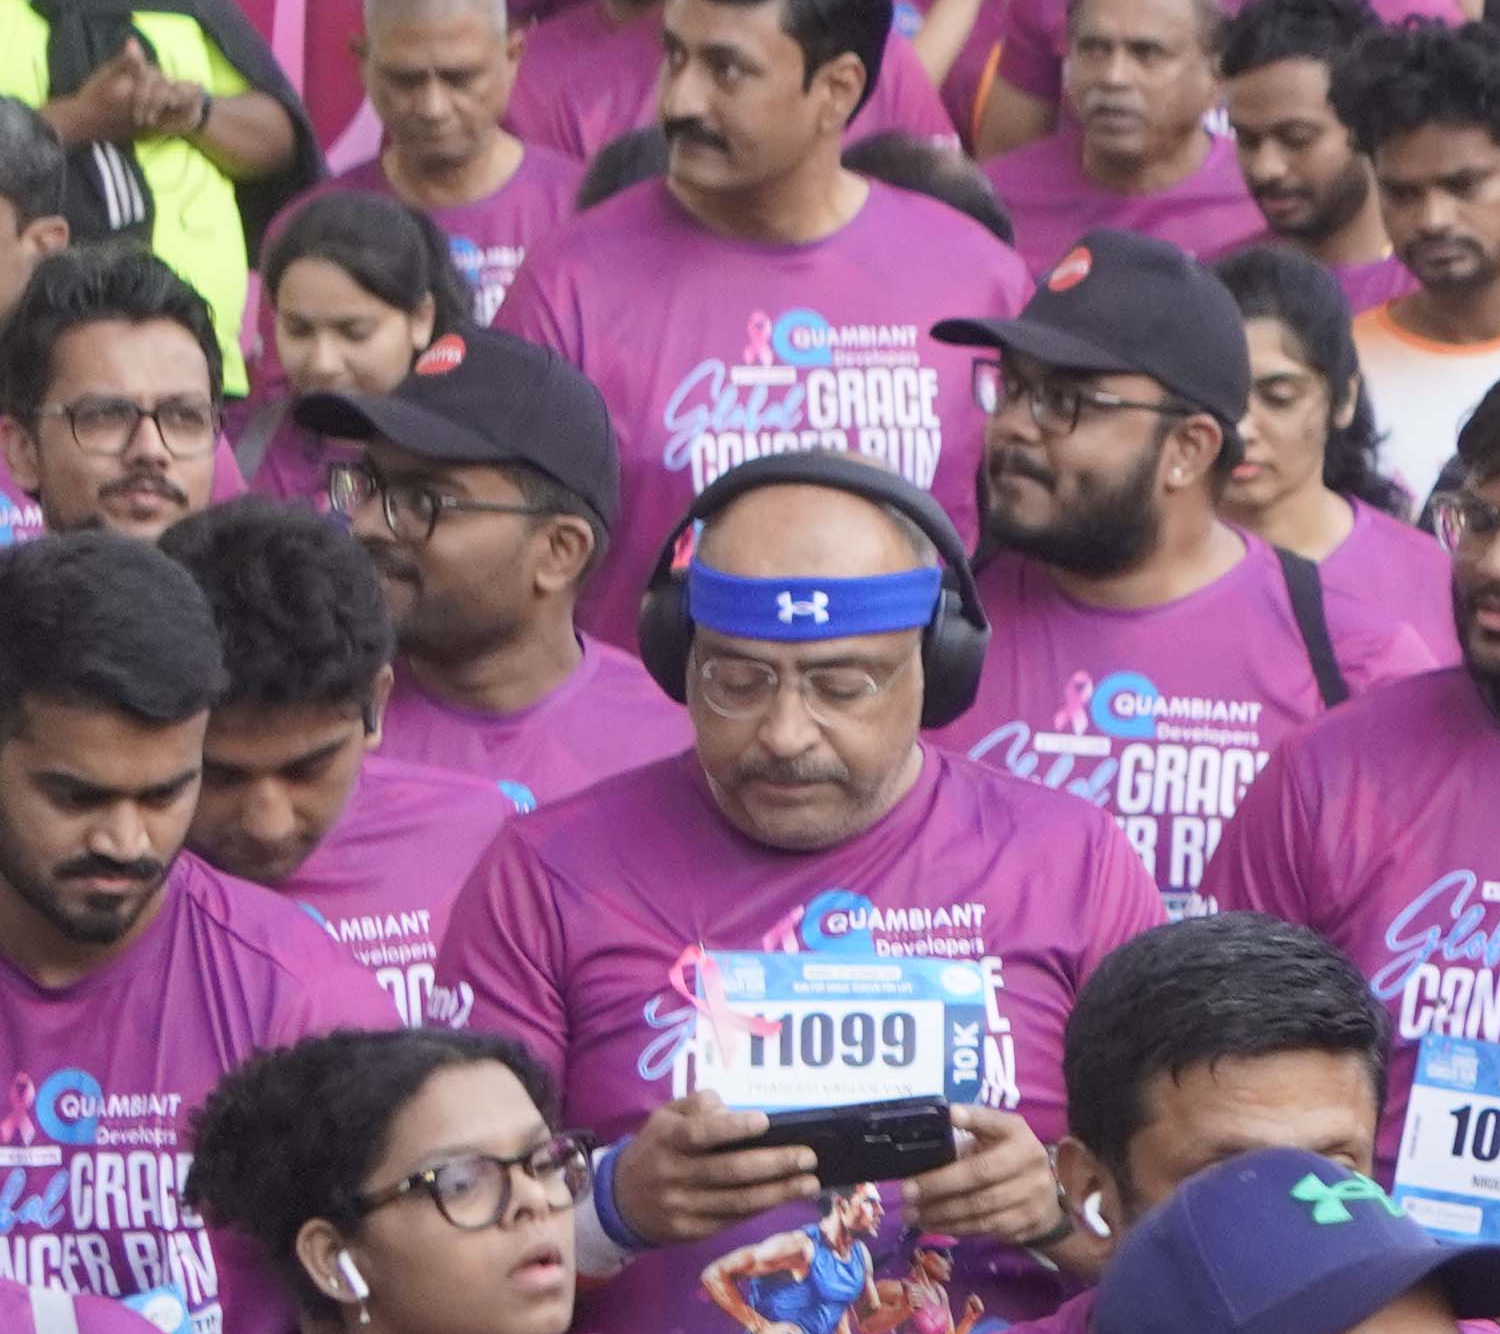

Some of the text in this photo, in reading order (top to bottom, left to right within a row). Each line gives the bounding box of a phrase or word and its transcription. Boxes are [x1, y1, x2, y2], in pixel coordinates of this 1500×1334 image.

[793, 324, 918, 350] QUAMBIANT
[662, 361, 940, 472] Global GRACE
[860, 430, 942, 491] RUN
[1114, 692, 1262, 729] QUAMBIANT
[1155, 721, 1260, 747] Developers
[1118, 744, 1270, 817] GRAC
[326, 909, 431, 945] AMBIANT
[826, 904, 986, 934] QUAMBIANT
[357, 939, 437, 969] velopers
[749, 1012, 918, 1069] 11099
[952, 1020, 981, 1085] 10K
